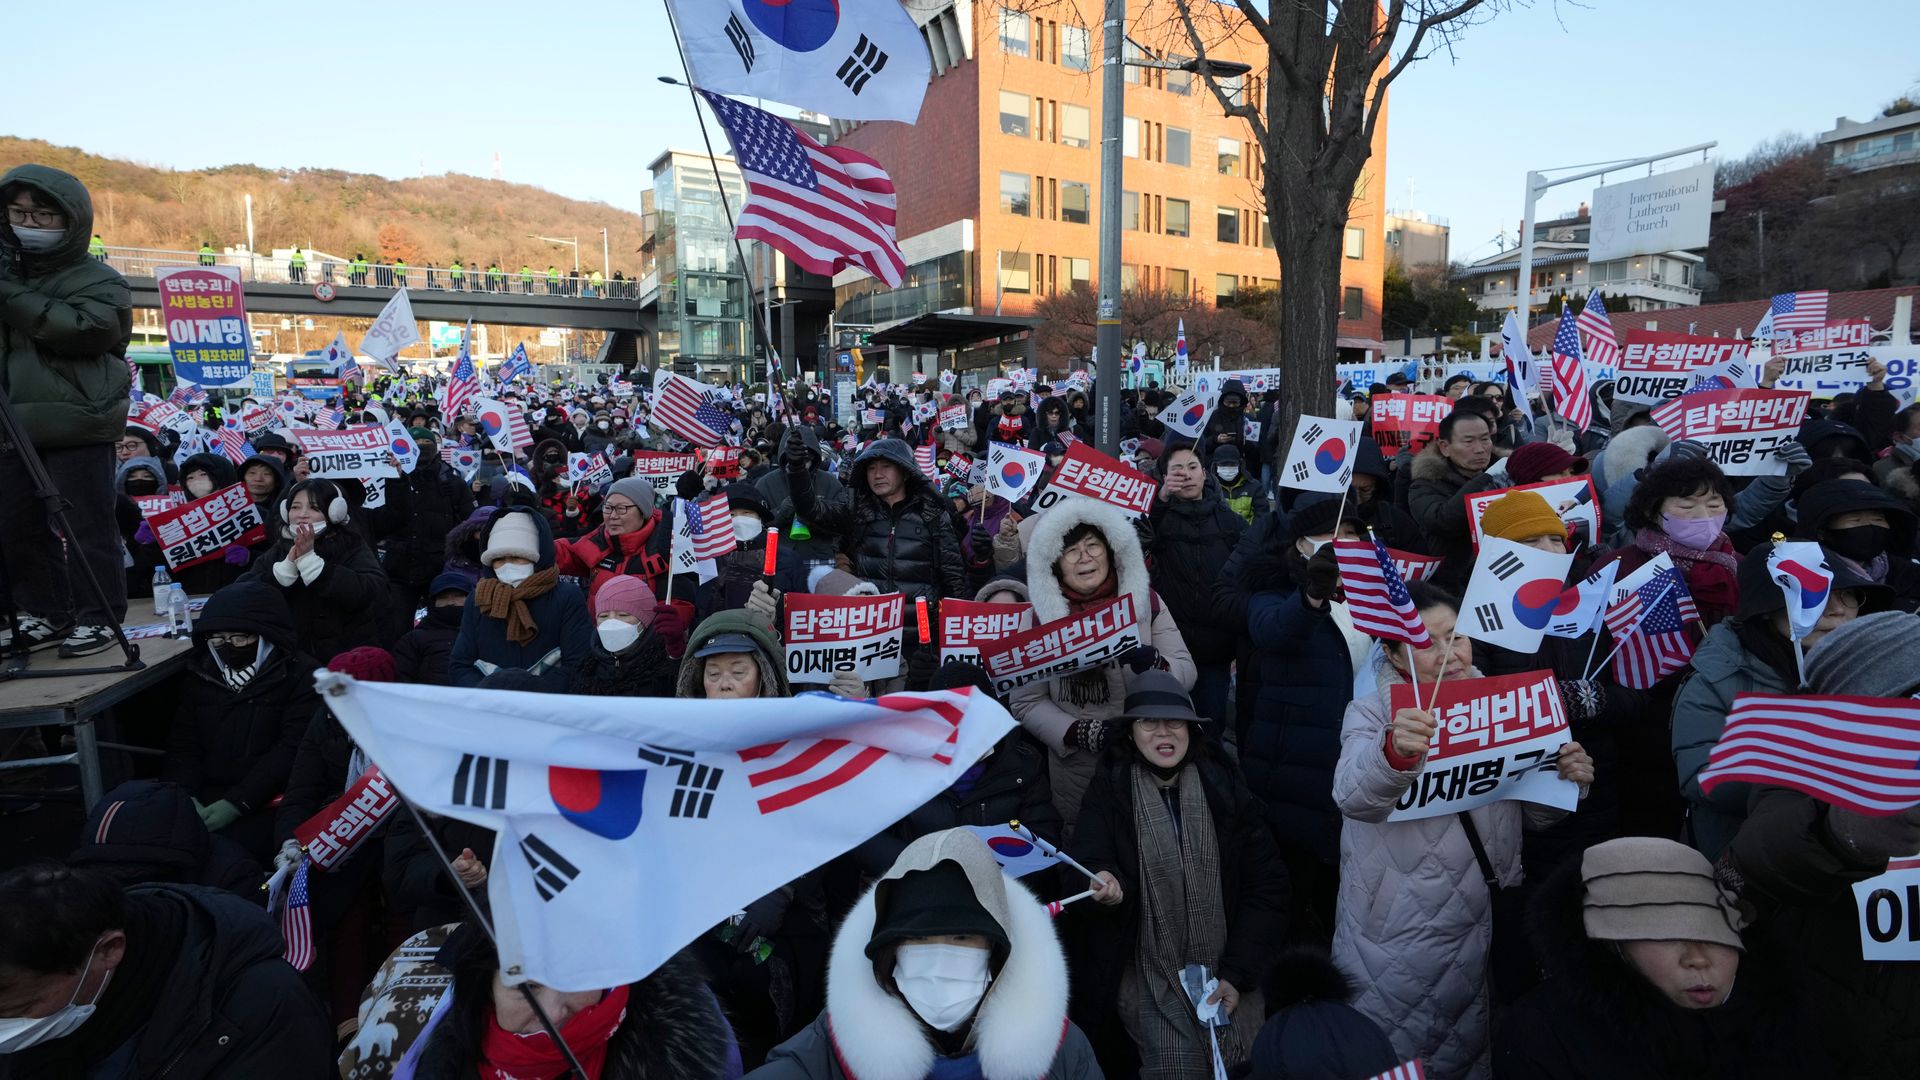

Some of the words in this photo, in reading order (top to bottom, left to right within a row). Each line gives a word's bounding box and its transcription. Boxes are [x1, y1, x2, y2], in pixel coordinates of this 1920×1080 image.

[1629, 178, 1699, 205] International
[1628, 202, 1680, 219] Lutheran
[1626, 216, 1668, 234] Church
[169, 295, 233, 308] 사법농단!!
[170, 319, 243, 344] 이재명
[175, 349, 197, 363] 긴급
[199, 348, 245, 362] 체포하라!!
[1623, 343, 1749, 370] 탄핵반대
[1836, 351, 1870, 370] 구속
[202, 365, 248, 379] 체포하라!!
[1352, 370, 1375, 388] 모집
[253, 389, 274, 397] STEAL
[255, 381, 271, 389] THE
[1616, 376, 1688, 398] 이재명
[1373, 399, 1406, 422] 탄핵
[1685, 395, 1809, 436] 탄핵반대
[301, 429, 389, 450] 탄핵반대
[308, 453, 362, 474] 이재명
[635, 456, 694, 474] 탄핵반대
[639, 475, 669, 490] 재명
[1055, 458, 1156, 512] 탄핵반대
[157, 485, 249, 547] 불법영장
[169, 509, 262, 566] 원천무효
[790, 596, 903, 641] 탄핵반대
[944, 610, 1019, 645] 탄핵
[988, 597, 1131, 676] 탄핵반대
[788, 646, 856, 674] 이재명
[859, 636, 900, 667] 구속
[1394, 756, 1505, 812] 이재명
[307, 771, 398, 868] 탄핵반
